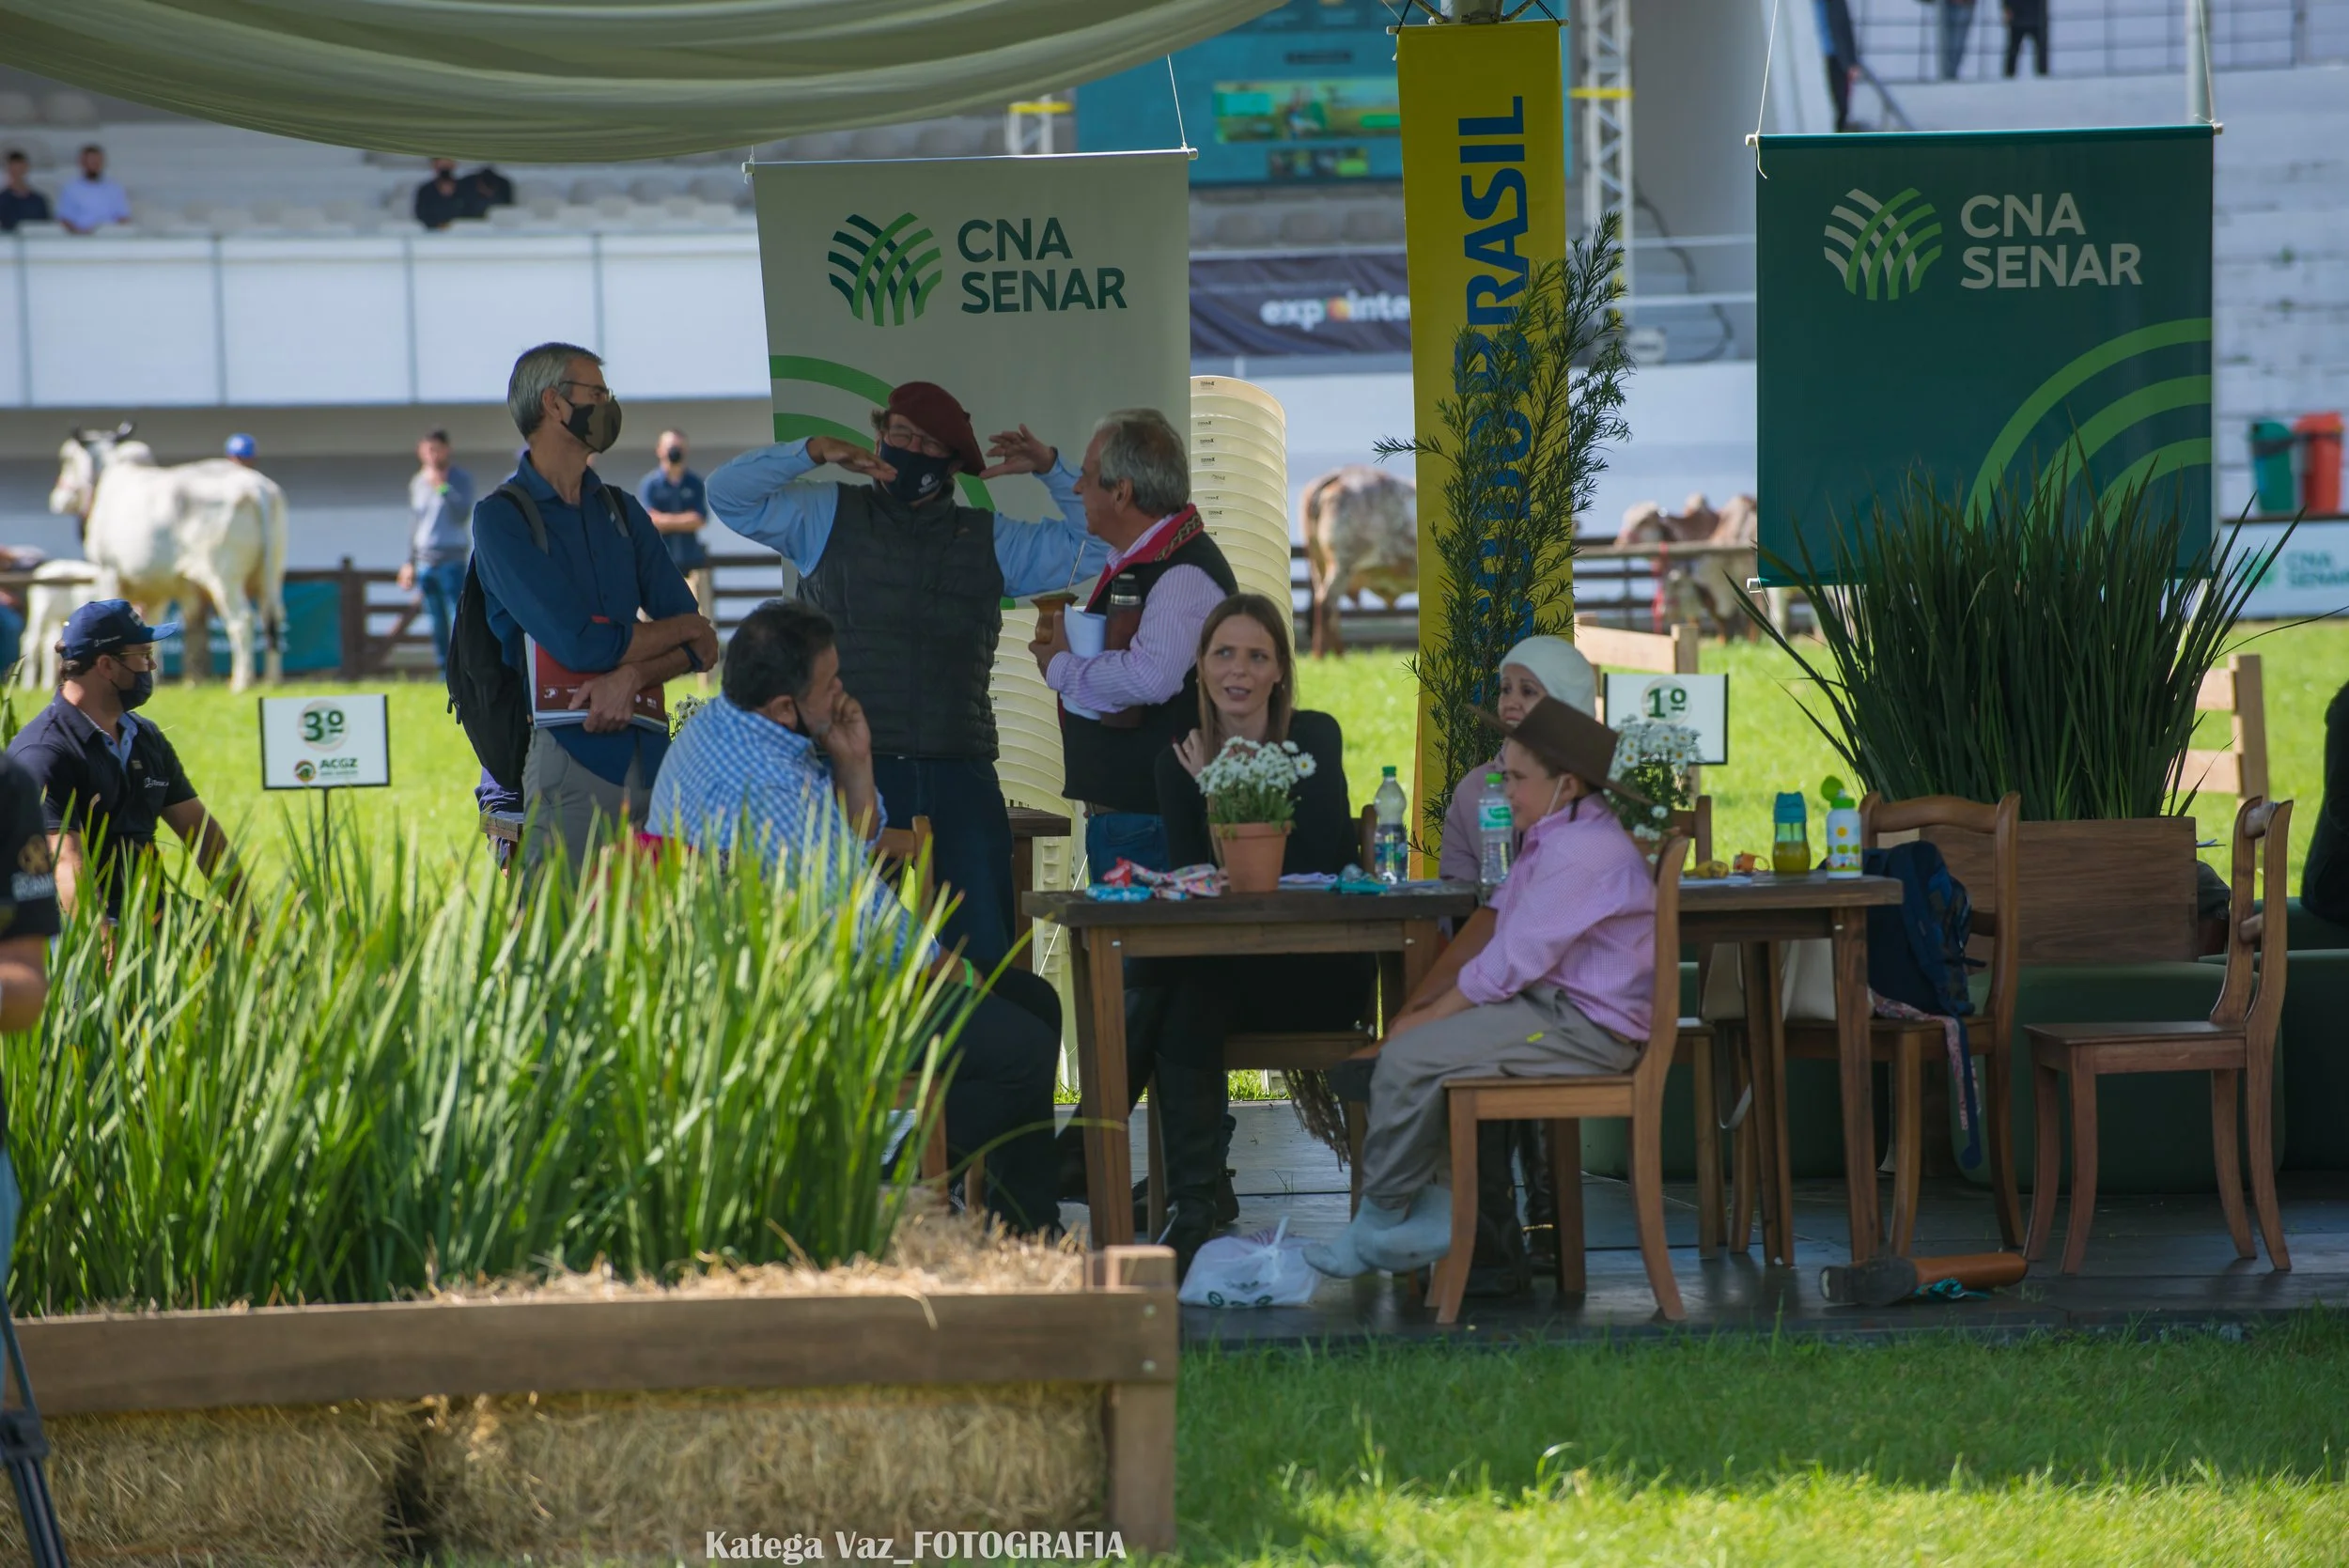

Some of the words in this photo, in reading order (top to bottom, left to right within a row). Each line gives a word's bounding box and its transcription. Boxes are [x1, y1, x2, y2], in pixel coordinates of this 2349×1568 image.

[1960, 193, 2086, 239] CNA
[957, 217, 1073, 263] CNA
[1453, 96, 1531, 394] BRASIL
[1960, 242, 2143, 289] SENAR
[960, 268, 1128, 315] SENAR
[1260, 287, 1409, 332] expointe
[303, 710, 345, 742] 3º
[1647, 687, 1688, 719] 1º
